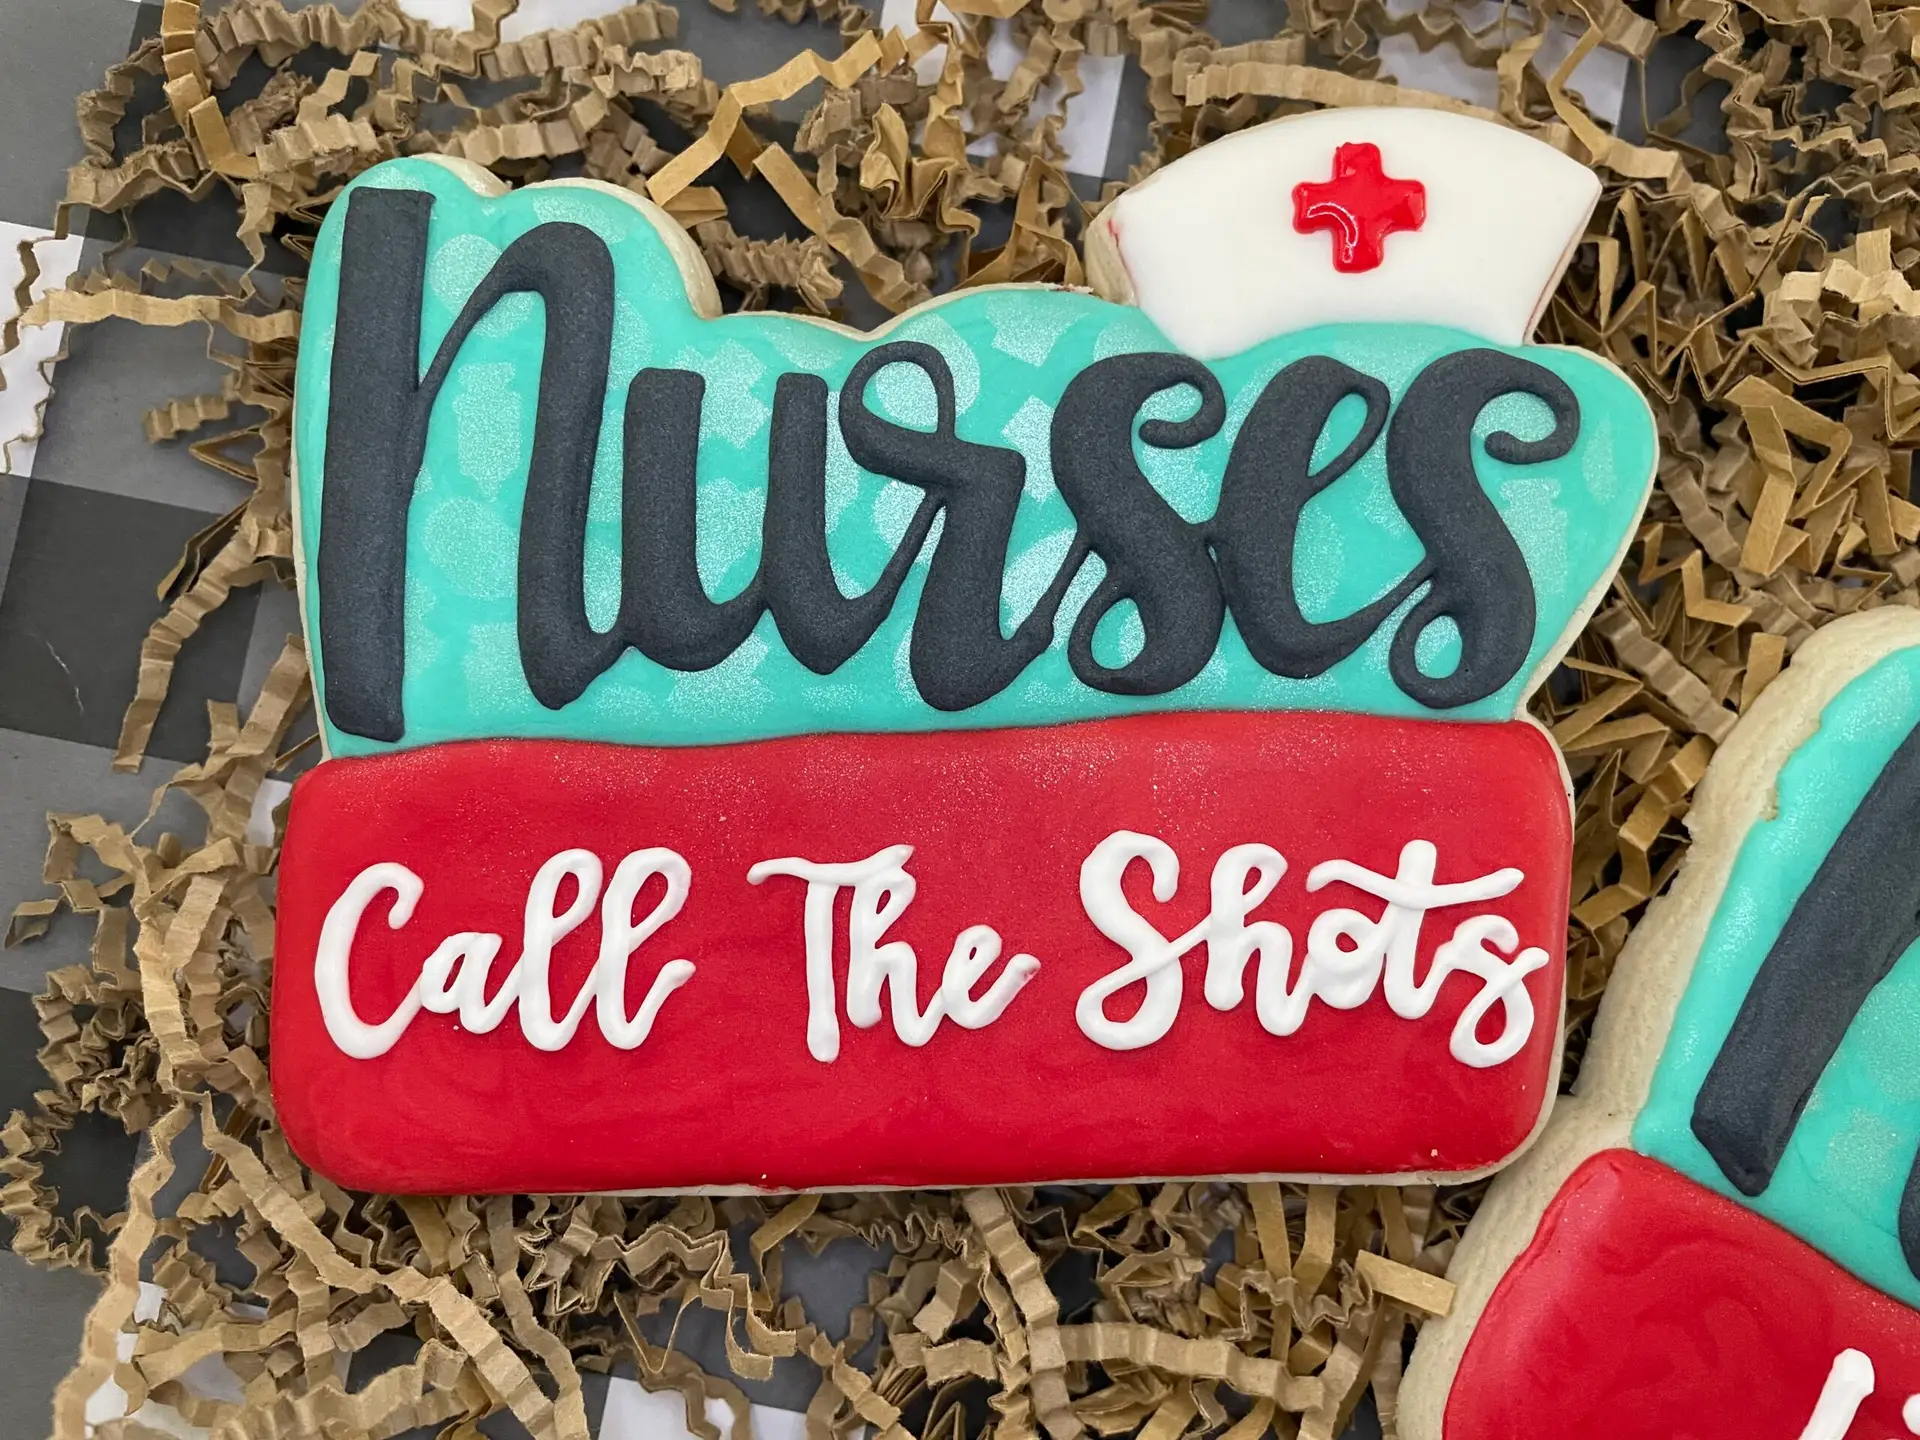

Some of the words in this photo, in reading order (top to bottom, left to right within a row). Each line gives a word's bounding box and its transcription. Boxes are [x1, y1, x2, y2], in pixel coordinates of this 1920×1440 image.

[317, 187, 1580, 743] Nurses
[315, 848, 695, 1058] Call
[748, 845, 1040, 1061] The
[1076, 830, 1549, 1067] Shots
